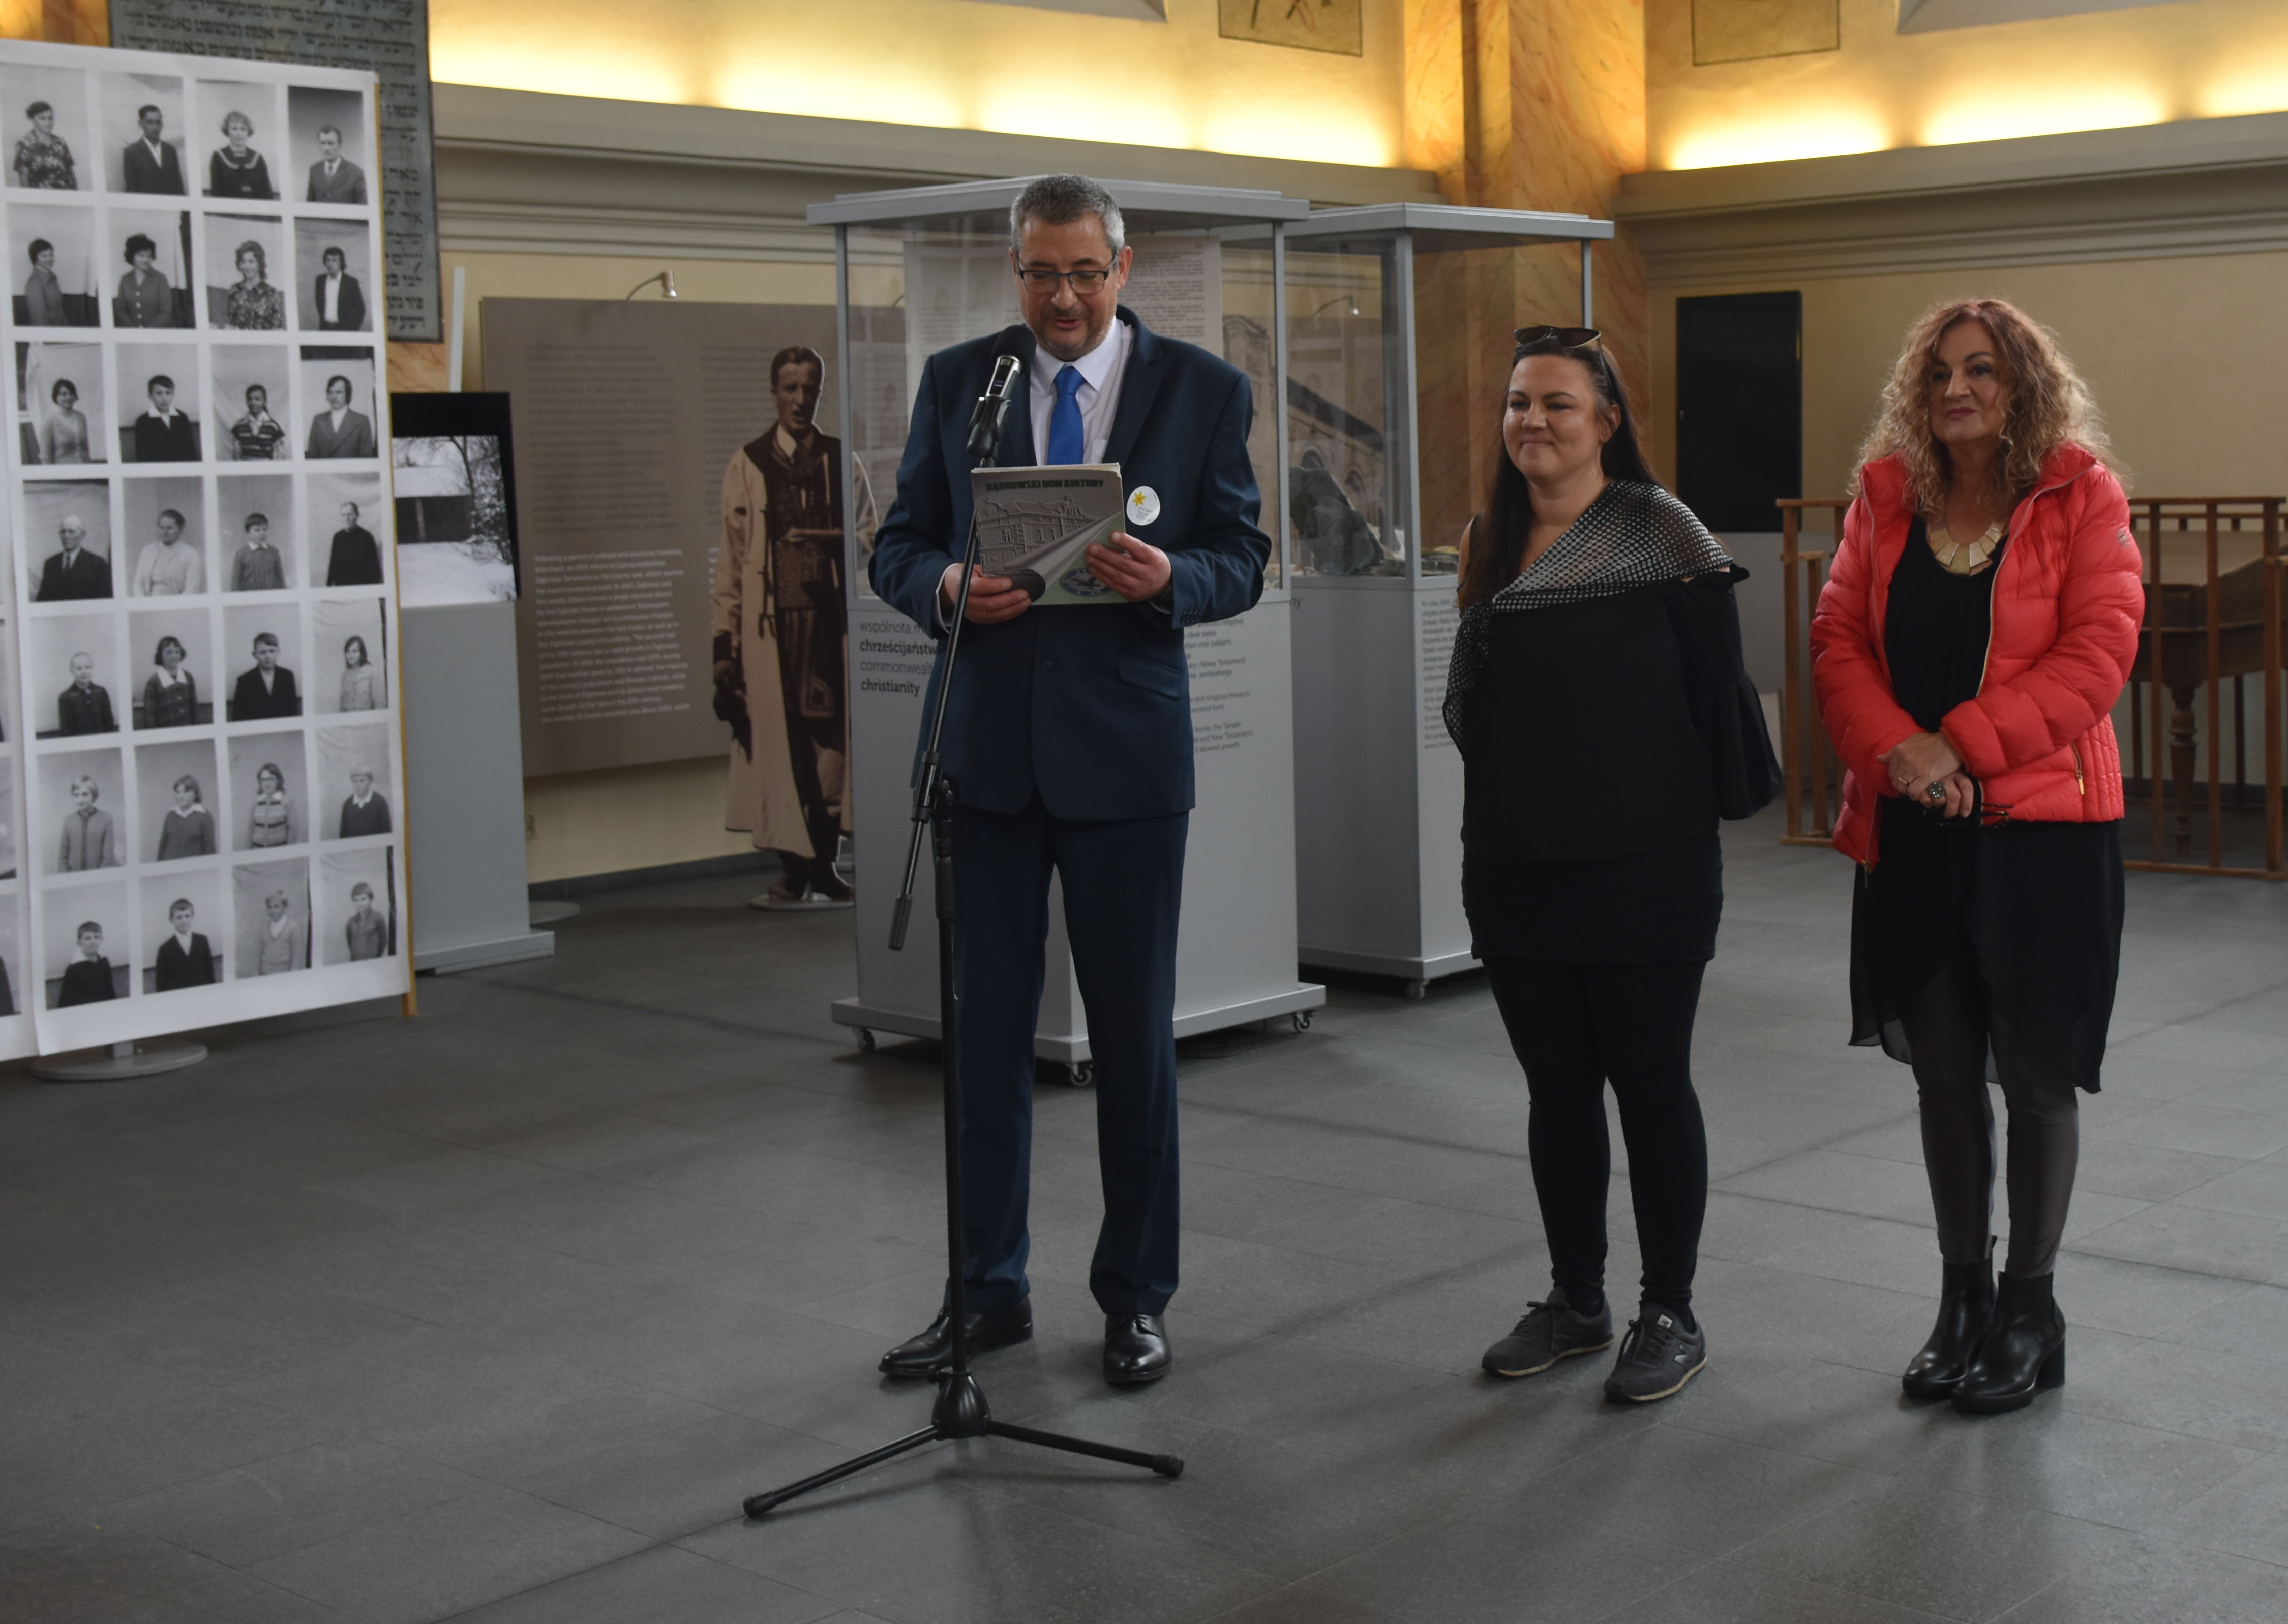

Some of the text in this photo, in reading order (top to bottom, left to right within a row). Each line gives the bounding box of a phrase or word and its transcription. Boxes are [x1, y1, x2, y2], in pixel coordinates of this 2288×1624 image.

[985, 479, 1104, 492] DĄBROWSKI DOM KULTURY
[859, 620, 912, 634] wspólnota
[860, 639, 937, 656] chrześcijaństw
[861, 678, 920, 697] christianity
